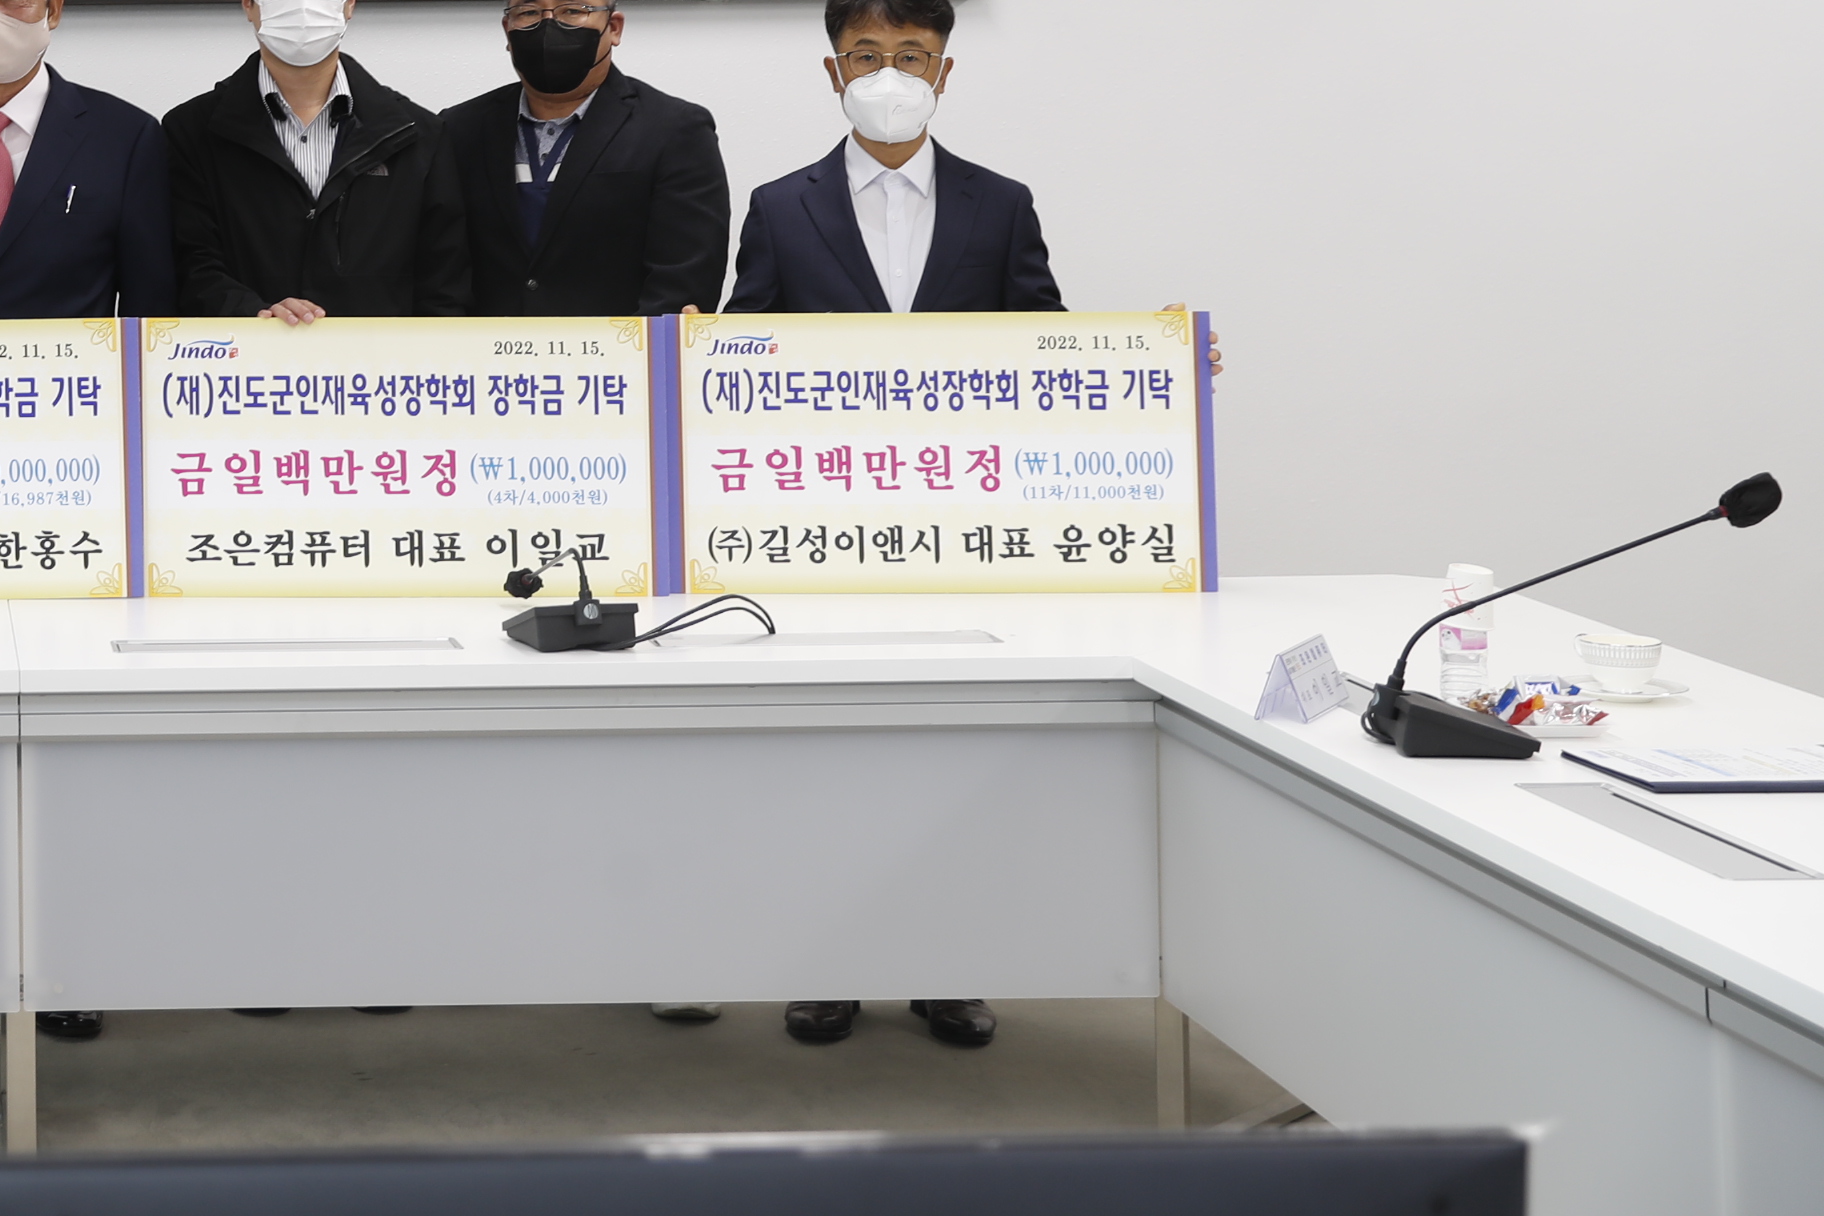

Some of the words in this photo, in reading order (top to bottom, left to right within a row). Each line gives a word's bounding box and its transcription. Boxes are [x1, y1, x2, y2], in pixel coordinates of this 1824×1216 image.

[23, 344, 45, 359] 11.
[56, 344, 78, 358] 15.
[494, 341, 538, 356] 2022.
[549, 341, 571, 356] 11.
[582, 341, 604, 356] 15.
[1038, 336, 1082, 351] 2022.
[1093, 336, 1116, 351] 11.
[1127, 336, 1149, 350] 15.
[52, 376, 101, 416] 기탁
[163, 373, 475, 418] (재)진도군인재육성장학회
[488, 374, 564, 416] 장학금
[578, 375, 627, 415] 기탁
[703, 368, 1018, 414] (재)진도군인재육성장학회
[1032, 368, 1109, 411] 장학금
[1123, 369, 1173, 409] 기탁
[171, 449, 456, 497] 금일백만원정
[711, 445, 1000, 493] 금일백만원정
[488, 489, 607, 505] (4차/4,000천원)
[1023, 484, 1164, 500] (11차/11,000천원)
[186, 530, 369, 567] 조은컴퓨터
[392, 530, 465, 567] 대표
[487, 529, 609, 569] 이일교
[708, 525, 940, 564] (주)길성이앤시
[962, 525, 1034, 563] 대표
[1054, 524, 1176, 564] 윤양실
